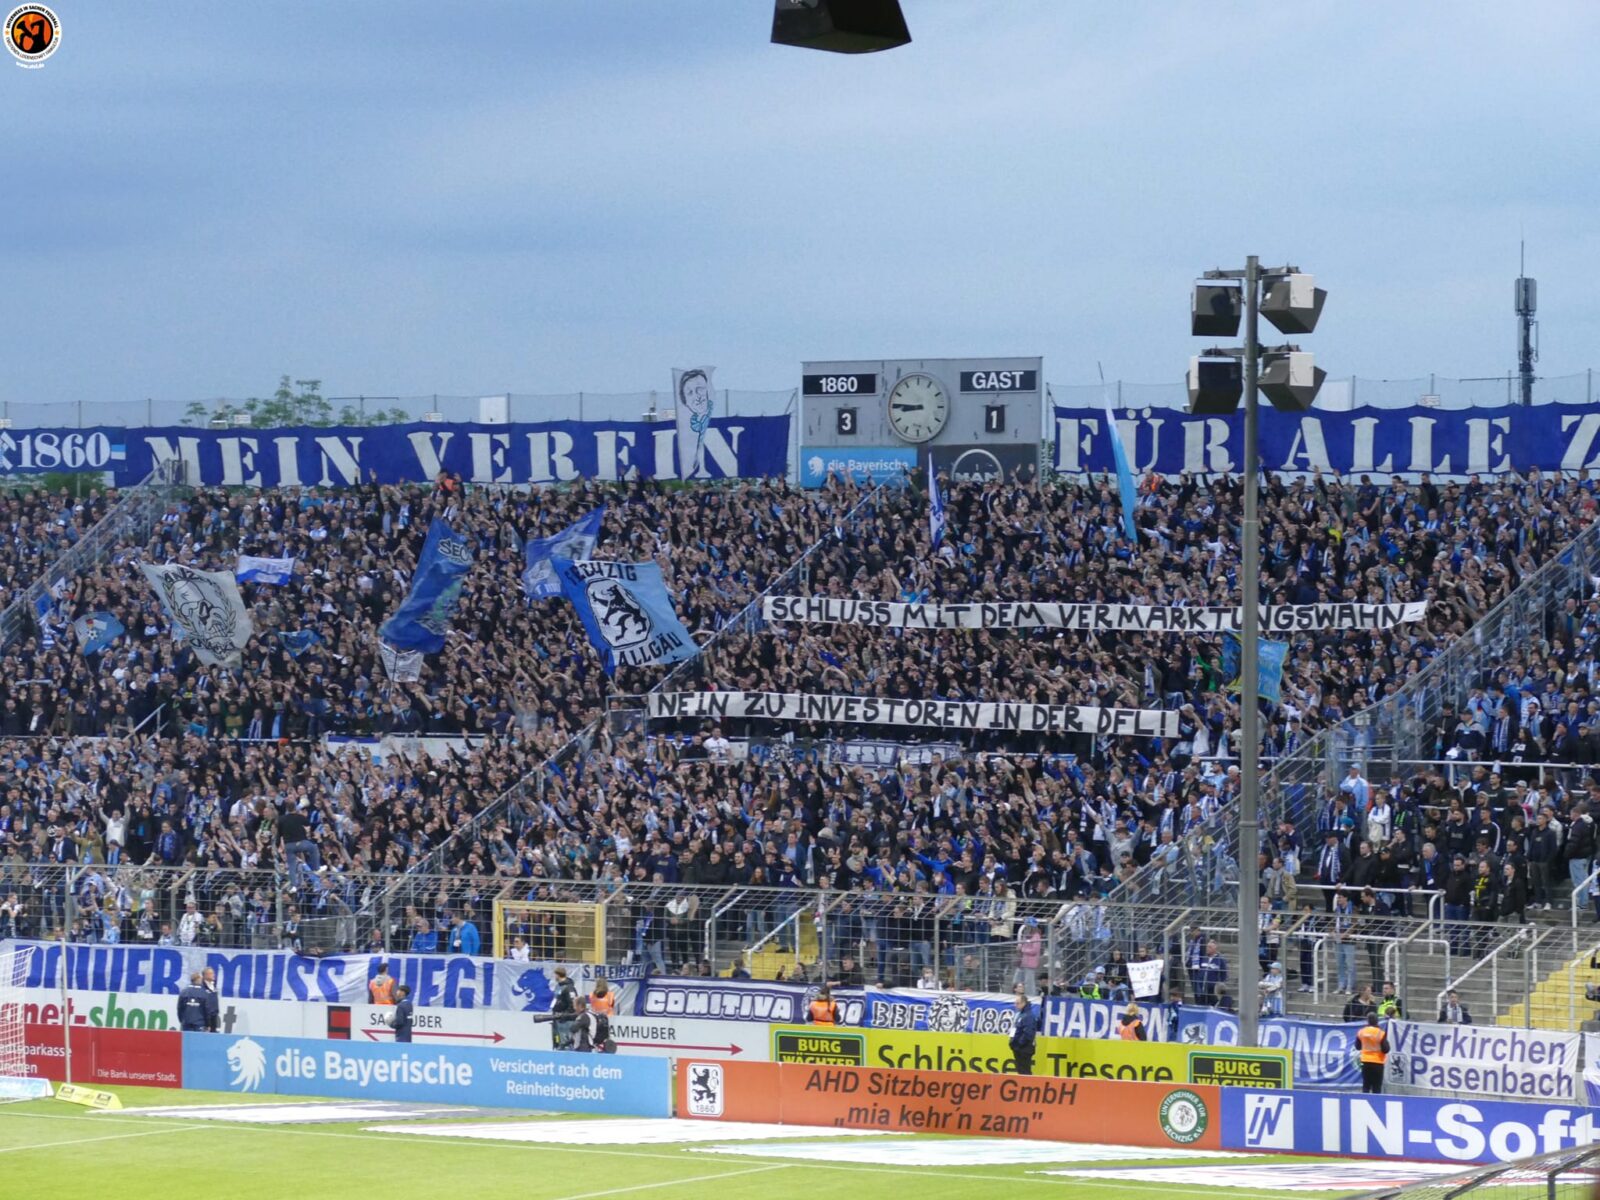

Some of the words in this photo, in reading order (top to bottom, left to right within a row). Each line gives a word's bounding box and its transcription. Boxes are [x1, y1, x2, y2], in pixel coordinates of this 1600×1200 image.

[819, 377, 858, 393] 1860
[972, 371, 1024, 389] GAST
[841, 413, 851, 431] 3
[990, 410, 998, 429] 1
[17, 431, 111, 468] 1860
[1055, 407, 1236, 475] FÜR
[1280, 416, 1511, 475] ALLE
[144, 435, 363, 487] MEIN
[407, 426, 745, 484] VEREIN
[828, 459, 845, 471] die
[848, 459, 909, 473] Bayerische
[771, 598, 892, 626] SCHLUSS
[981, 603, 1046, 627] DEM
[1058, 602, 1406, 630] VERMARKTUNGSWAHN
[618, 631, 683, 667] ALLGÄU
[744, 692, 786, 717] ZU
[1032, 705, 1083, 732] DER
[1099, 710, 1167, 736] DFL!
[207, 951, 346, 1004] MUSS
[645, 989, 793, 1021] COMITIVA
[872, 1002, 926, 1028] BBF
[370, 1013, 443, 1029] SAUBER
[609, 1024, 676, 1041] AMHUBER
[798, 1038, 841, 1053] BURG
[1391, 1023, 1566, 1065] Vierkirchen
[98, 1068, 109, 1078] Die
[110, 1069, 128, 1079] Bank
[128, 1072, 155, 1081] unserer
[275, 1048, 317, 1079] die
[324, 1050, 473, 1087] Bayerische
[489, 1057, 555, 1075] Versichert
[558, 1059, 590, 1077] nach
[592, 1060, 623, 1080] dem
[879, 1043, 1036, 1074] Schlösse
[1047, 1053, 1174, 1083] Tresore
[1214, 1060, 1261, 1076] BURG
[1410, 1056, 1573, 1098] Pasenbach
[506, 1080, 605, 1102] Reinheitsgebot
[805, 1069, 860, 1093] AHD
[867, 1071, 992, 1105] Sitzberger
[1000, 1079, 1078, 1105] GmbH
